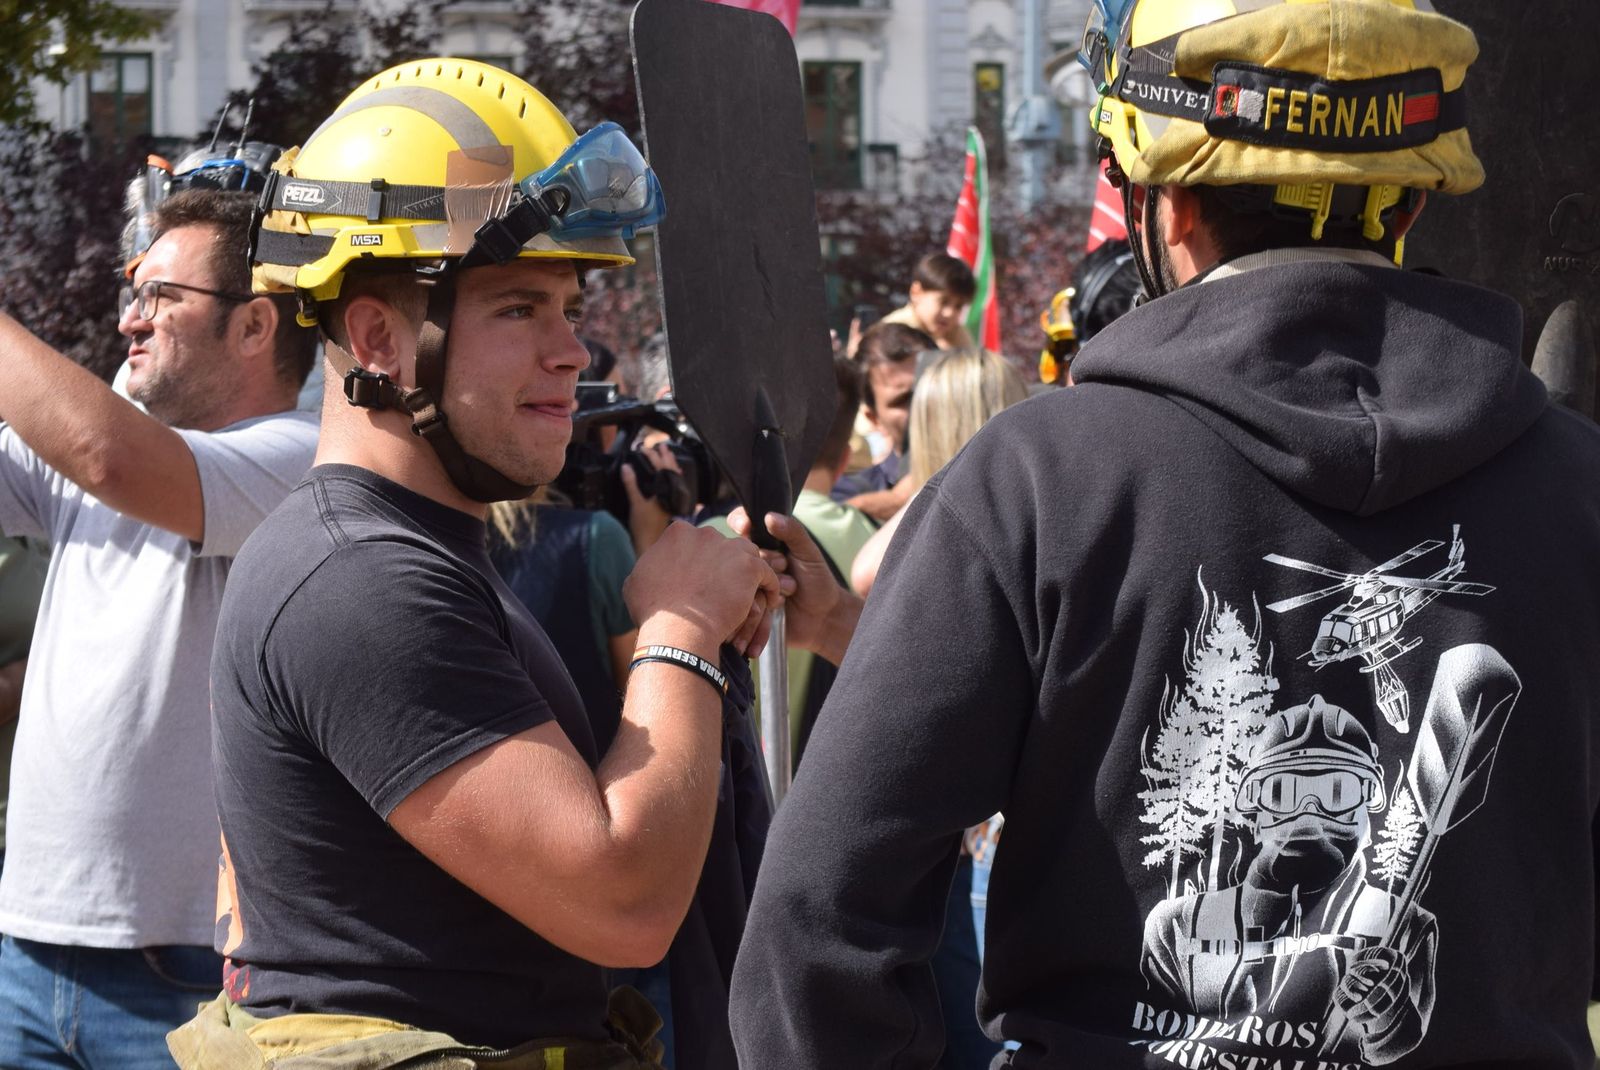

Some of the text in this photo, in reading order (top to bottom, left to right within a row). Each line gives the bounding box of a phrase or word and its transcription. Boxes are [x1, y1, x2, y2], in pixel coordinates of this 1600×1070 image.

[1264, 87, 1404, 138] FERNAN
[282, 184, 325, 206] PETZL
[351, 235, 382, 245] MSA
[648, 645, 726, 687] PARA SERVIR
